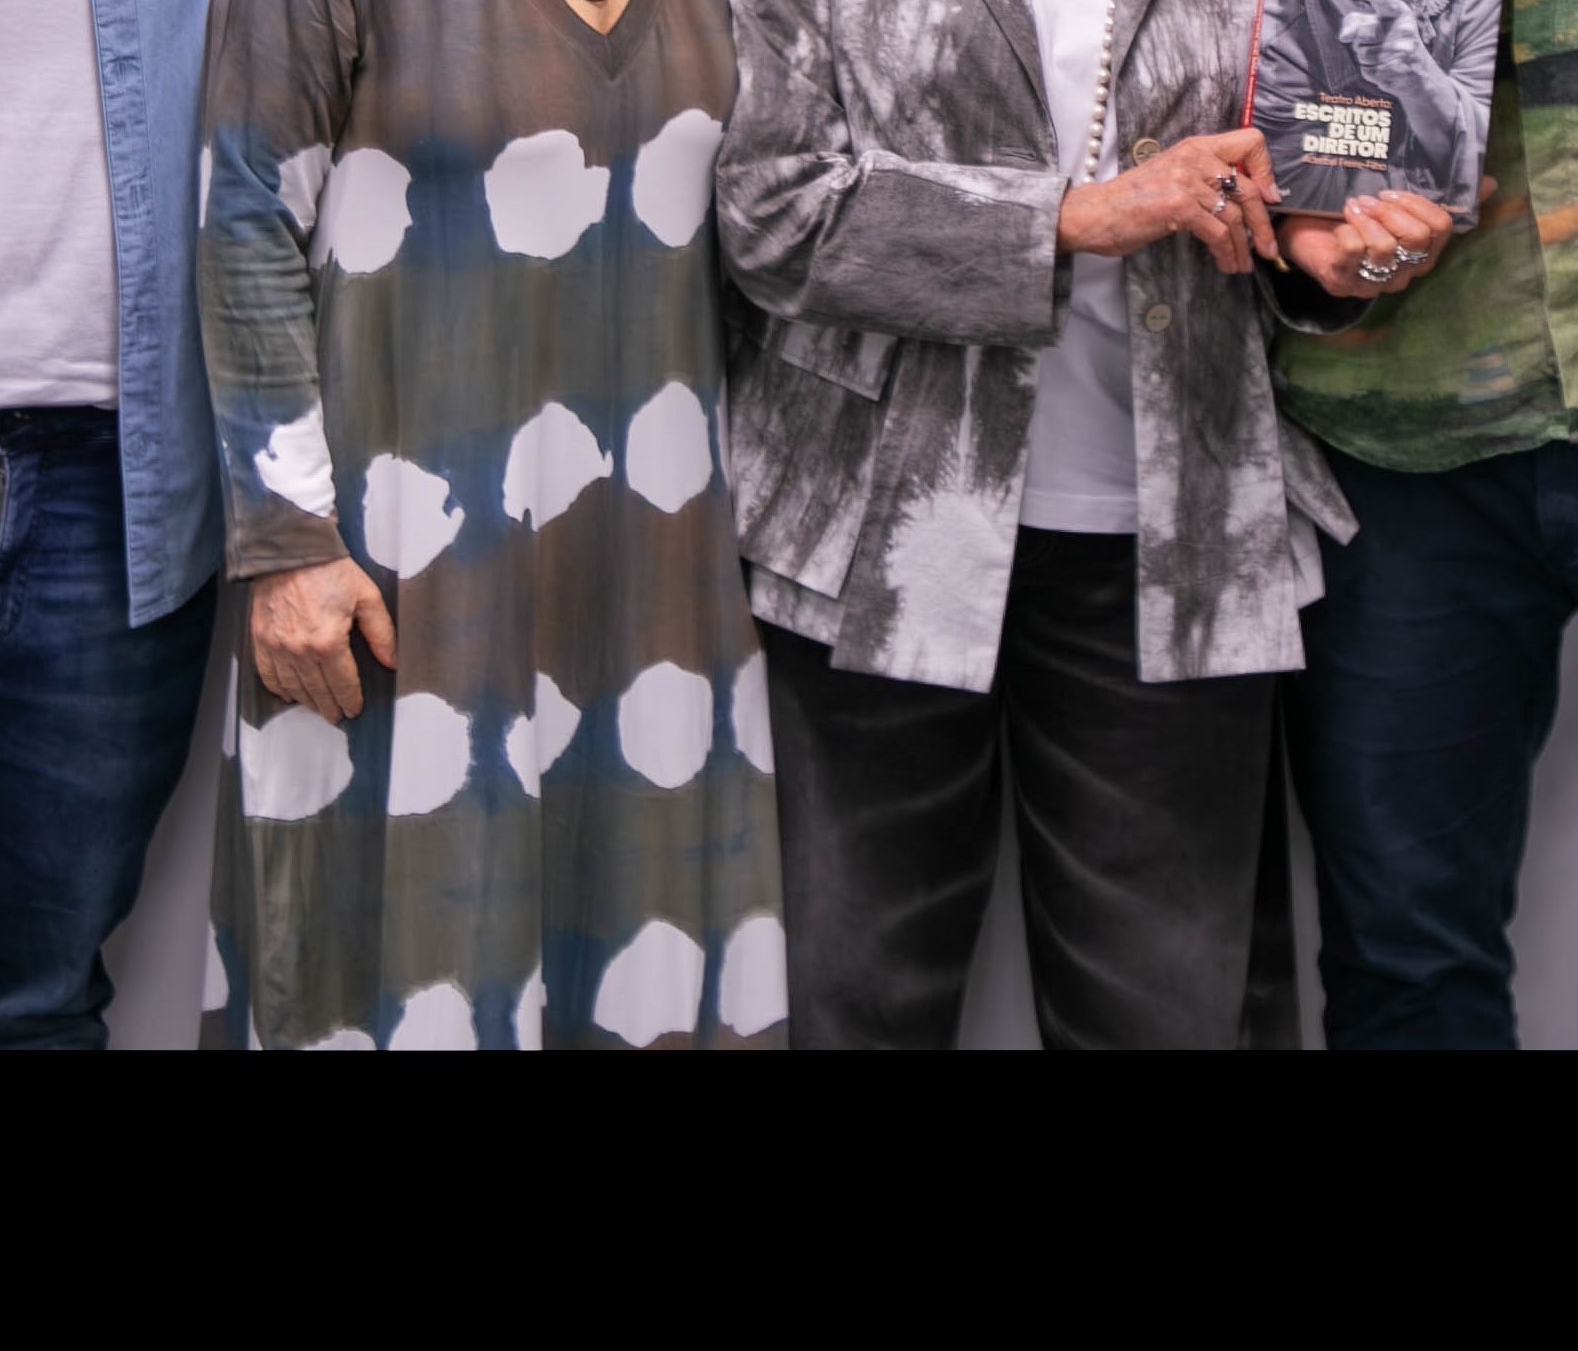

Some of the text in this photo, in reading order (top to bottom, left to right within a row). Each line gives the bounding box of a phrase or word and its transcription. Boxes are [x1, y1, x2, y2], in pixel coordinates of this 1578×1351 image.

[1295, 102, 1391, 127] ESCRITOS
[1329, 122, 1390, 142] DE UM
[1304, 134, 1388, 159] DIRETOR
